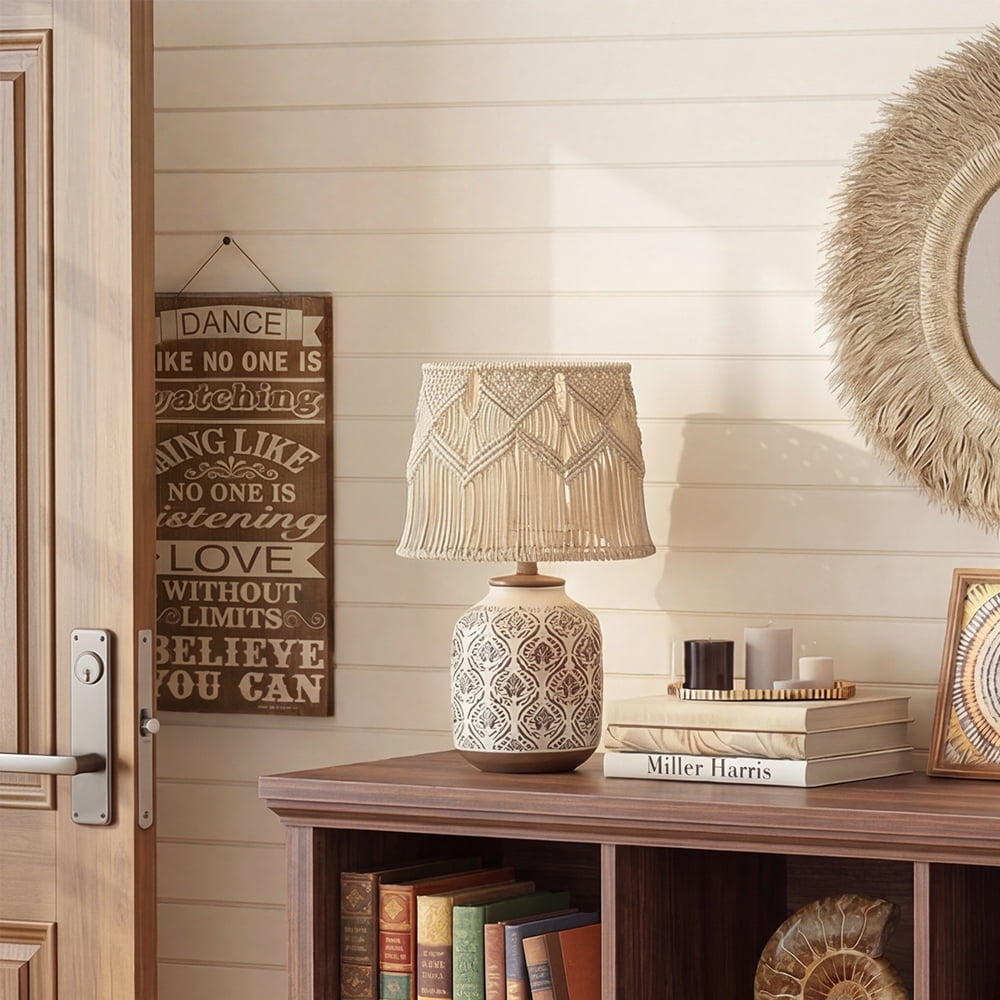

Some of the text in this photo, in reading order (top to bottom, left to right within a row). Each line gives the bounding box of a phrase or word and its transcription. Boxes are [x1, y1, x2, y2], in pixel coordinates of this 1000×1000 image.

[181, 310, 282, 336] DANCE
[156, 351, 322, 372] IKE NO ONE IS
[233, 428, 321, 474] LIKE
[167, 482, 296, 503] NO ONE IS
[155, 505, 327, 541] istening
[170, 544, 293, 574] LOVE
[162, 580, 302, 604] WITHOUT
[181, 606, 283, 630] LIMITS
[238, 672, 326, 703] CAN
[647, 755, 772, 780] Miller Harris
